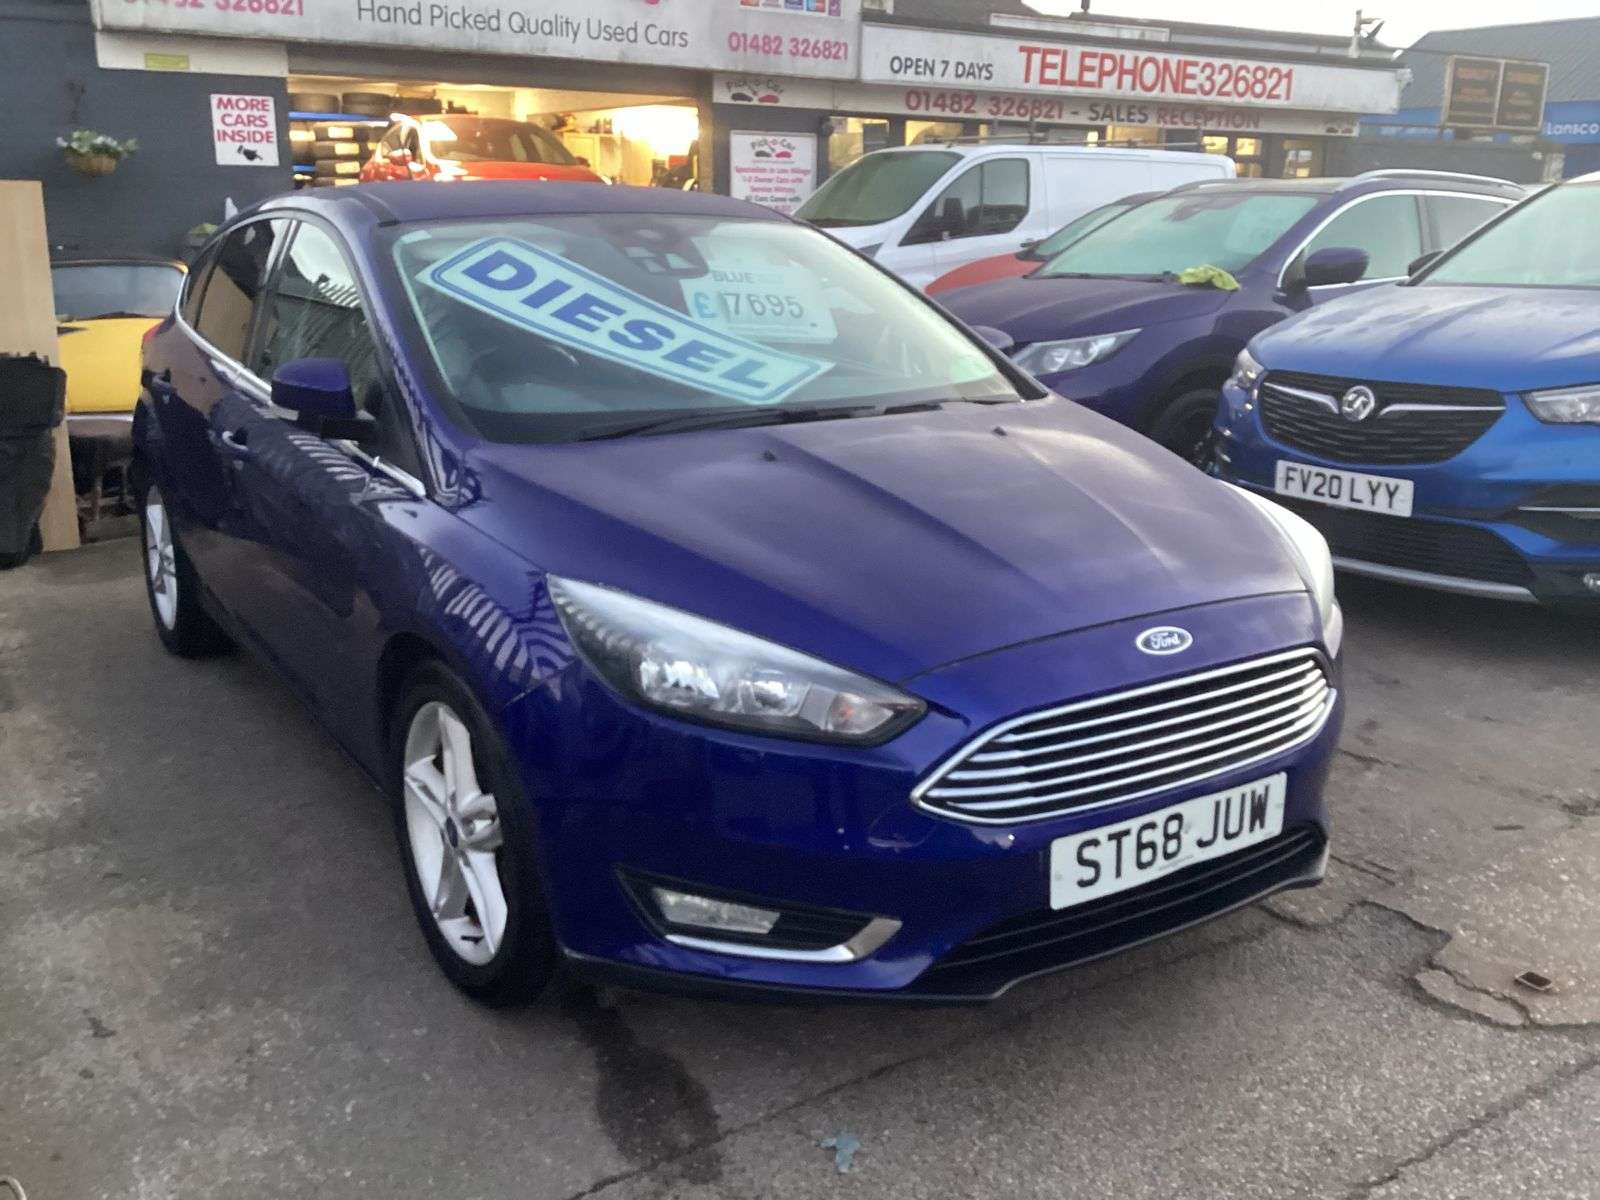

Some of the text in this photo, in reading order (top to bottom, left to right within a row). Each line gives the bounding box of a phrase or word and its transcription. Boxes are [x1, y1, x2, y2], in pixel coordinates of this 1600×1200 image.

[358, 0, 689, 48] Hand Picked Quality Used Cars
[728, 31, 848, 60] 01482 326821
[889, 56, 935, 76] OPEN
[940, 60, 950, 78] 7
[955, 62, 994, 80] DAYS
[217, 97, 271, 112] MORE
[905, 89, 977, 114] 01482
[988, 96, 1064, 119] 326821
[1088, 103, 1149, 123] SALES
[1156, 107, 1261, 129] RECEPTION
[221, 113, 268, 128] CARS
[217, 129, 274, 143] INSIDE
[712, 270, 755, 283] BLUE
[461, 249, 770, 389] DIESEL
[1284, 466, 1400, 509] FV20 LYY
[1150, 631, 1181, 649] Ford
[1076, 784, 1271, 888] ST68 JUW
